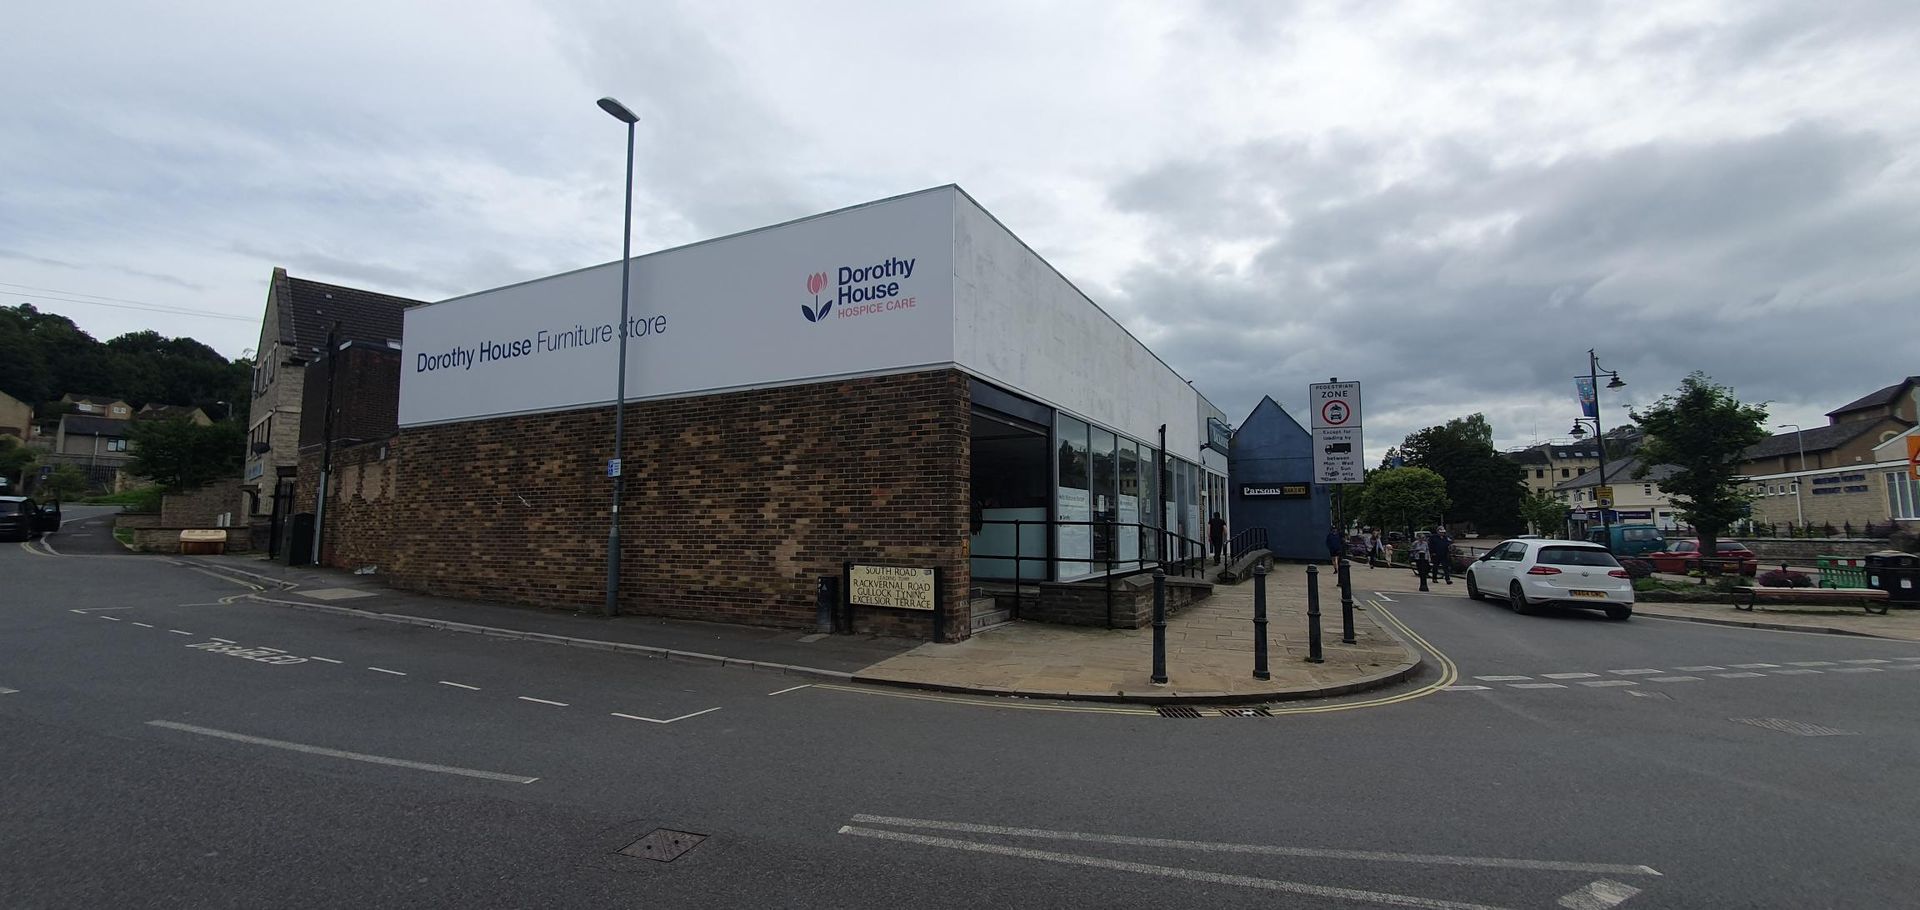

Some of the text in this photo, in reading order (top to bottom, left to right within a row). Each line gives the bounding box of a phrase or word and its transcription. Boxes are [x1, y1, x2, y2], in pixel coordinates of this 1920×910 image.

[838, 257, 916, 286] Dorothy
[838, 282, 899, 305] House
[838, 297, 917, 319] HOSPICE CARE
[417, 346, 475, 373] Dorothy
[480, 339, 532, 363] House
[537, 324, 613, 353] Furniture
[1321, 390, 1348, 399] ZONE
[1243, 487, 1281, 496] Parsons
[865, 566, 917, 577] SOUTH ROAD
[853, 579, 905, 590] RACKVERNAL
[907, 583, 931, 592] ROAD
[857, 588, 926, 600] GULLOCK TYNING
[852, 595, 932, 609] EXCELSIOR TERRACE
